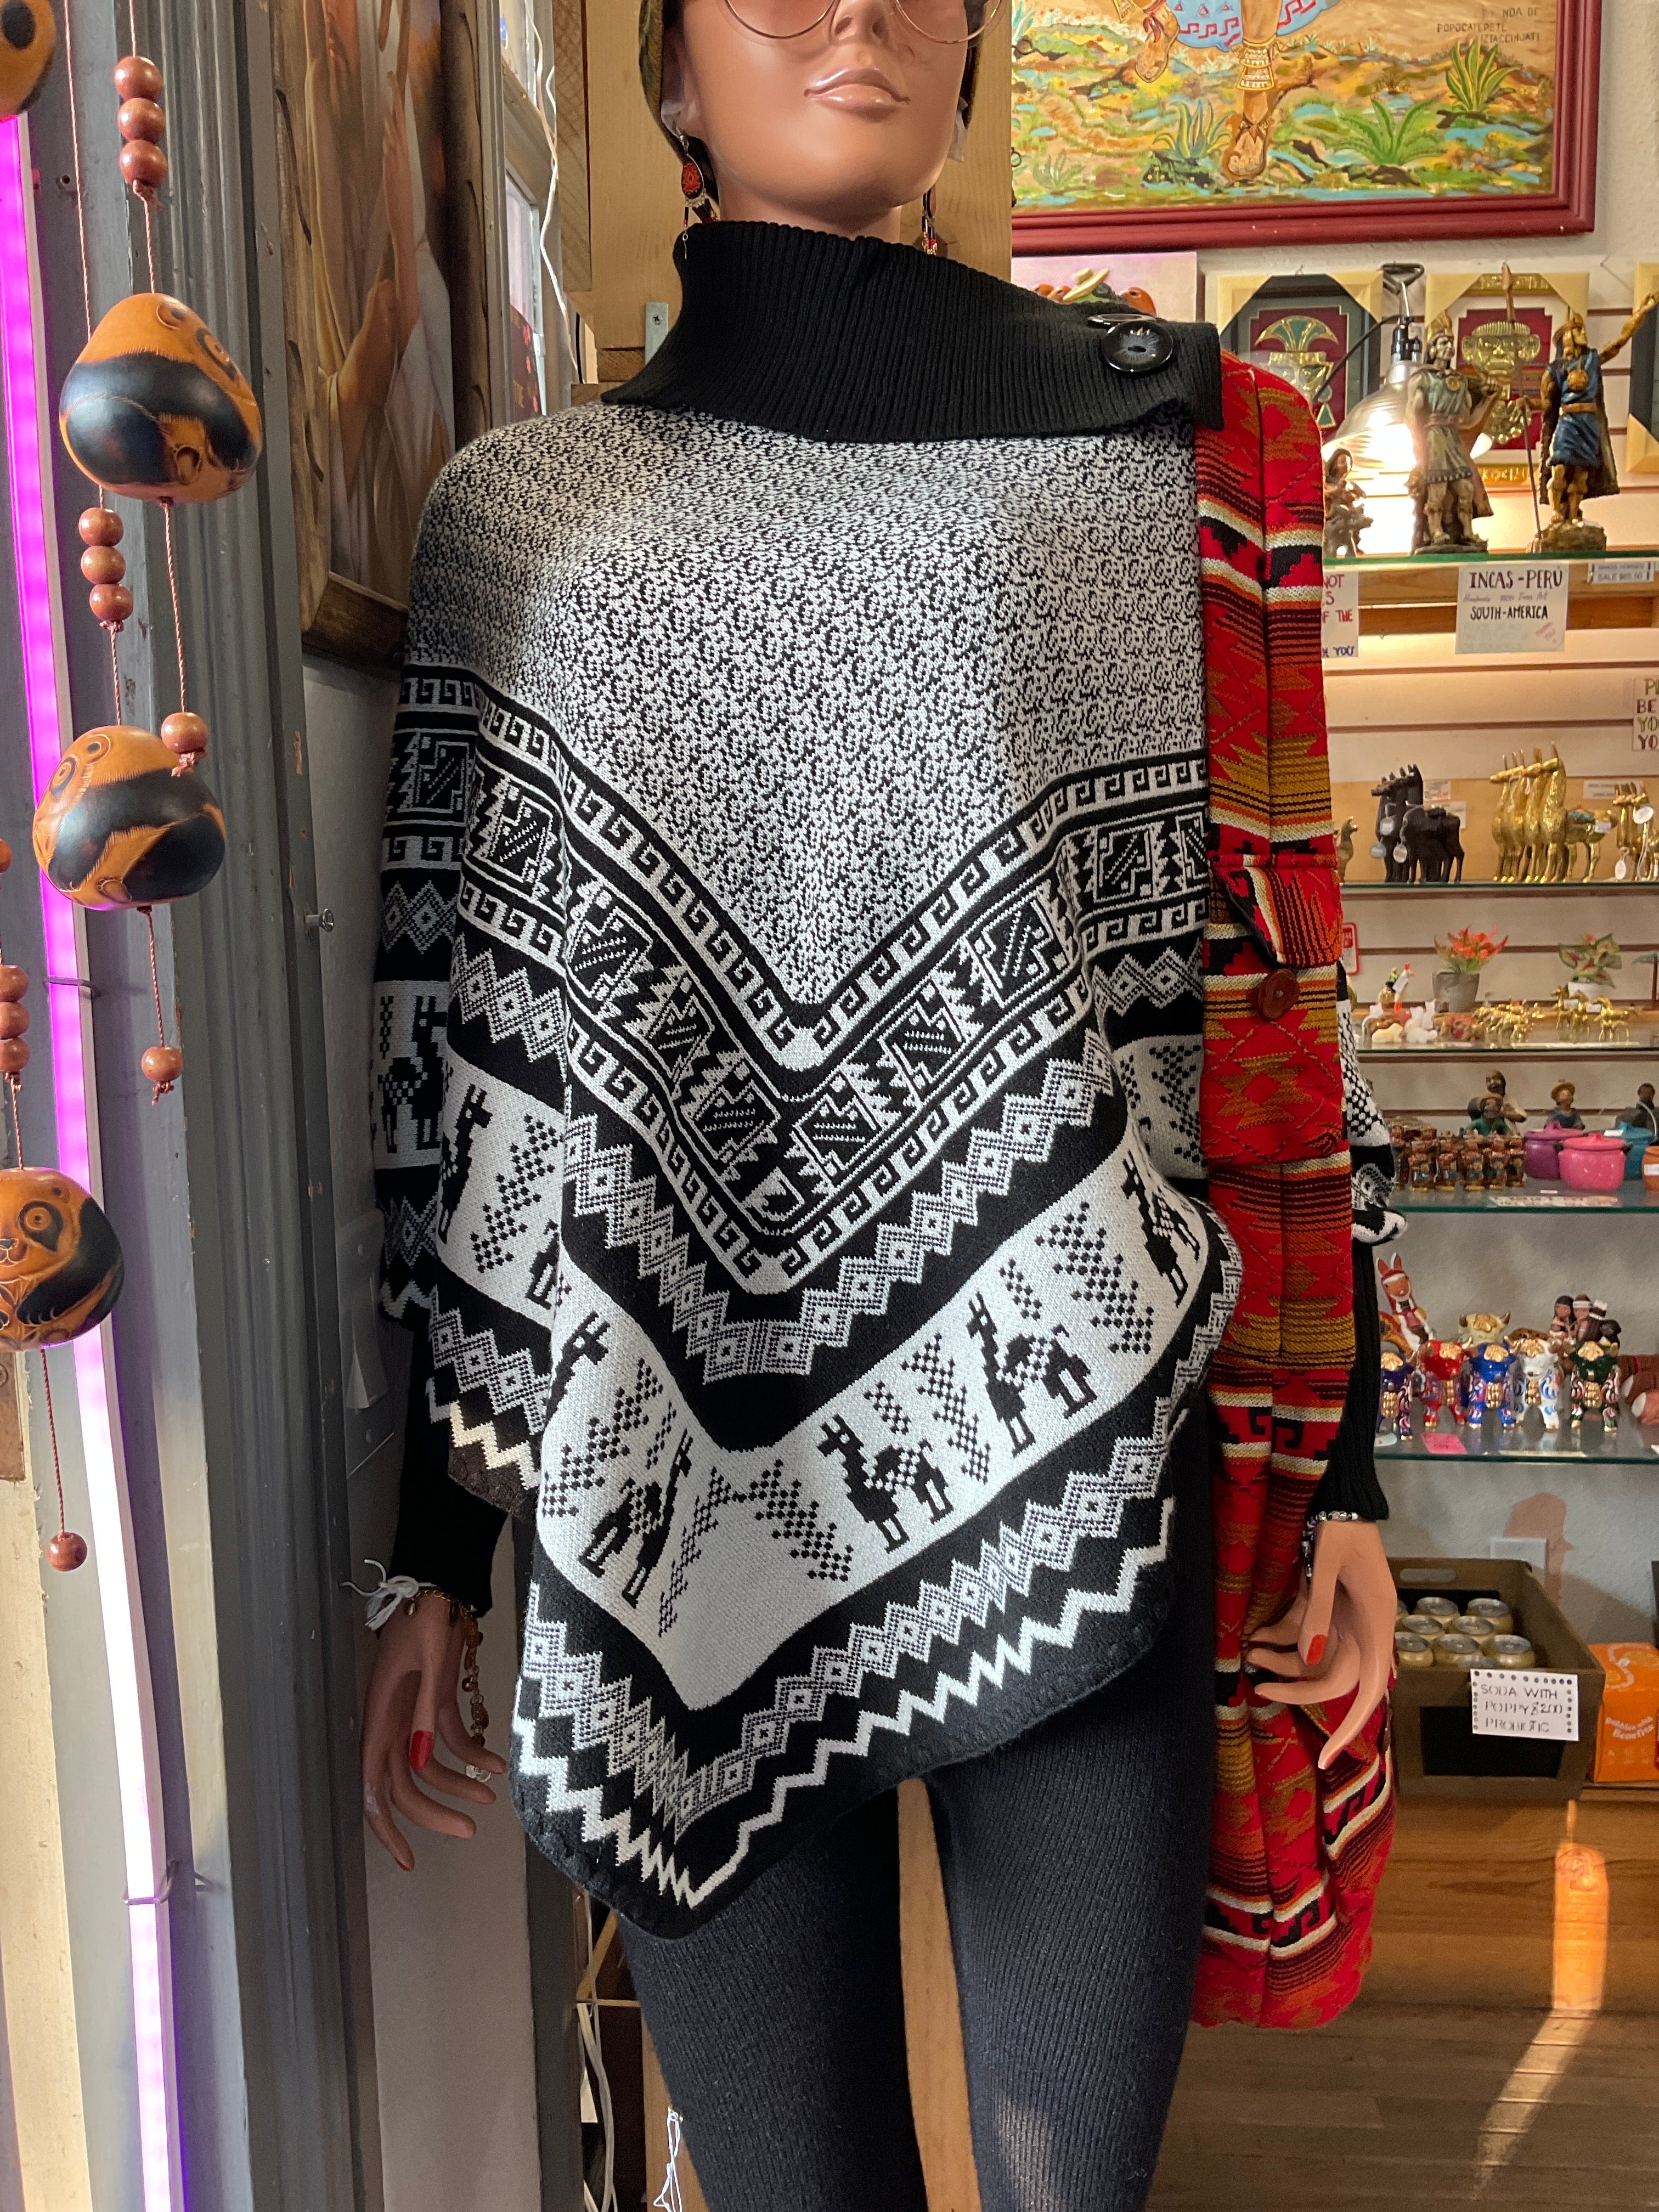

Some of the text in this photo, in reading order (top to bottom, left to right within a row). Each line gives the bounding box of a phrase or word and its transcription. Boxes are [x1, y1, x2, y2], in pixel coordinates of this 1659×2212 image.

[1470, 605, 1548, 620] SOUTH-AMERICA
[1637, 698, 1657, 714] BE
[1637, 716, 1659, 732] YO
[1481, 1684, 1558, 1700] SODA WITH
